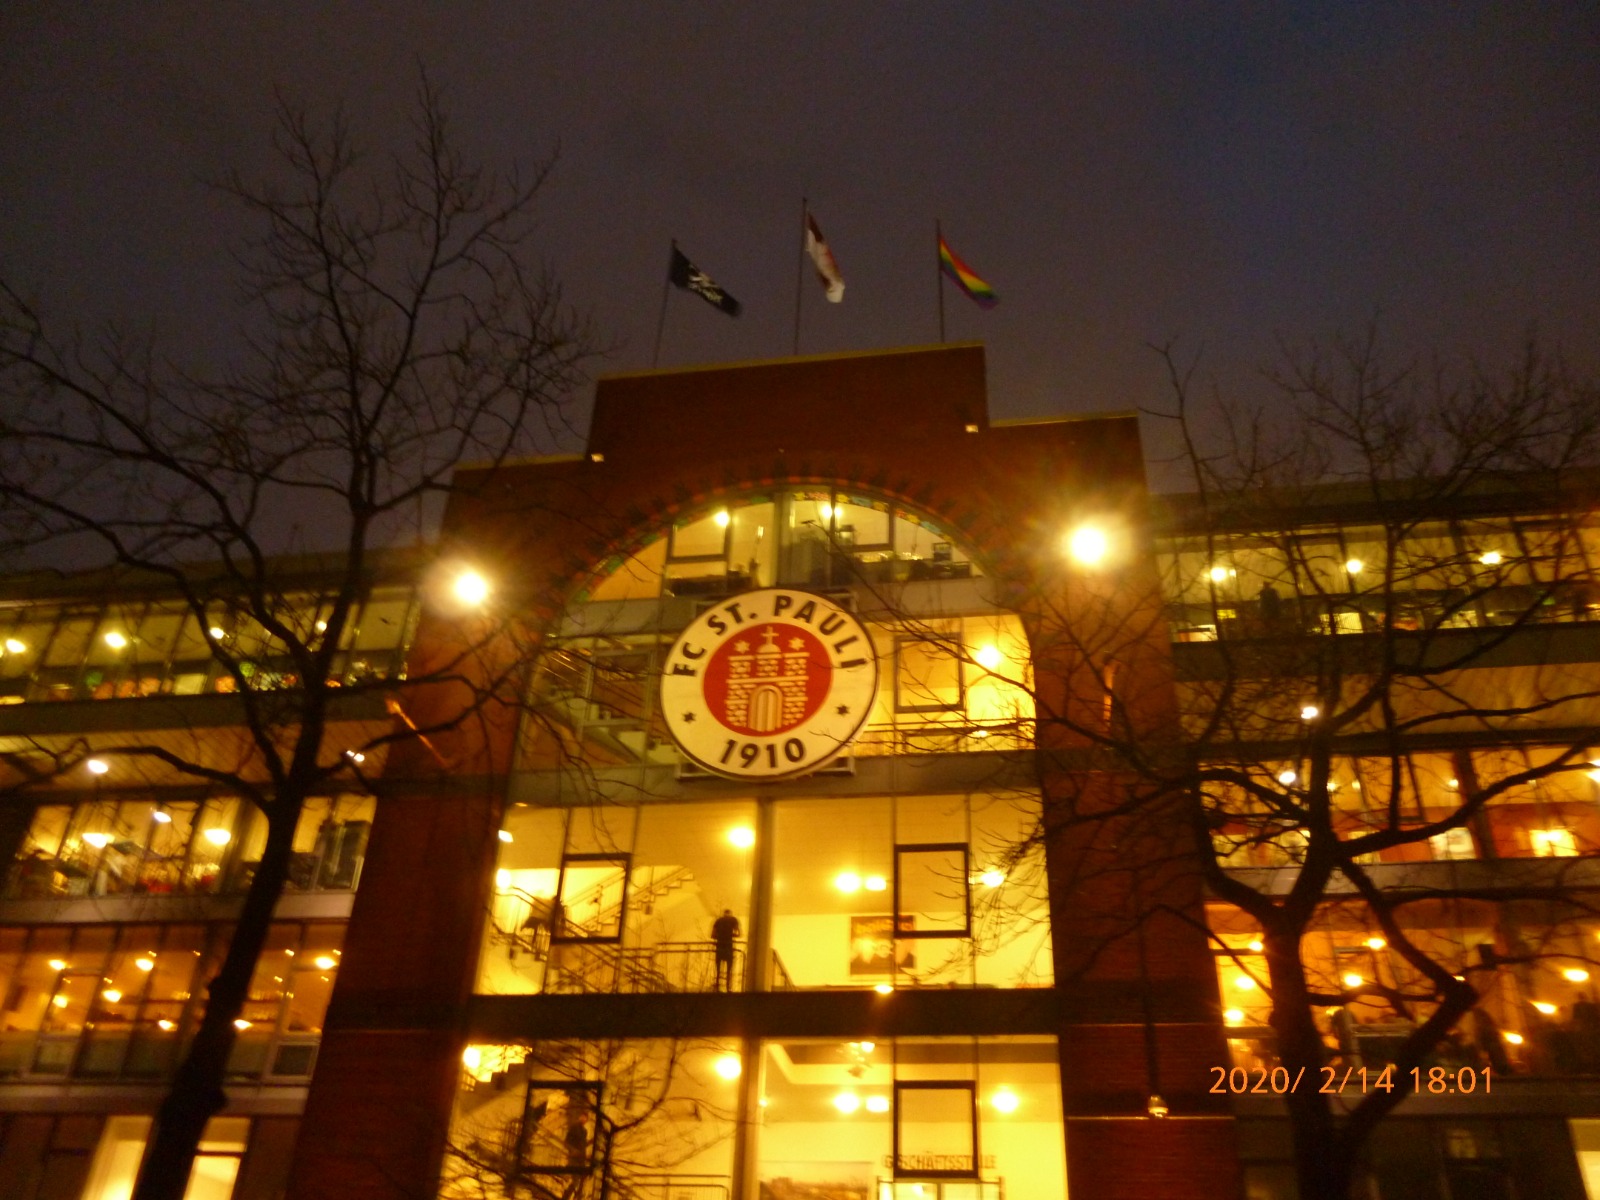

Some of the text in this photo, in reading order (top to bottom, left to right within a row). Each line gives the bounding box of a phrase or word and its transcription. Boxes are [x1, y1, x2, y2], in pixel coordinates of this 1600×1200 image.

[671, 595, 866, 677] FC ST. PAULI
[720, 738, 805, 769] 1910
[883, 1151, 997, 1170] GSCHÄFTSSTLLE
